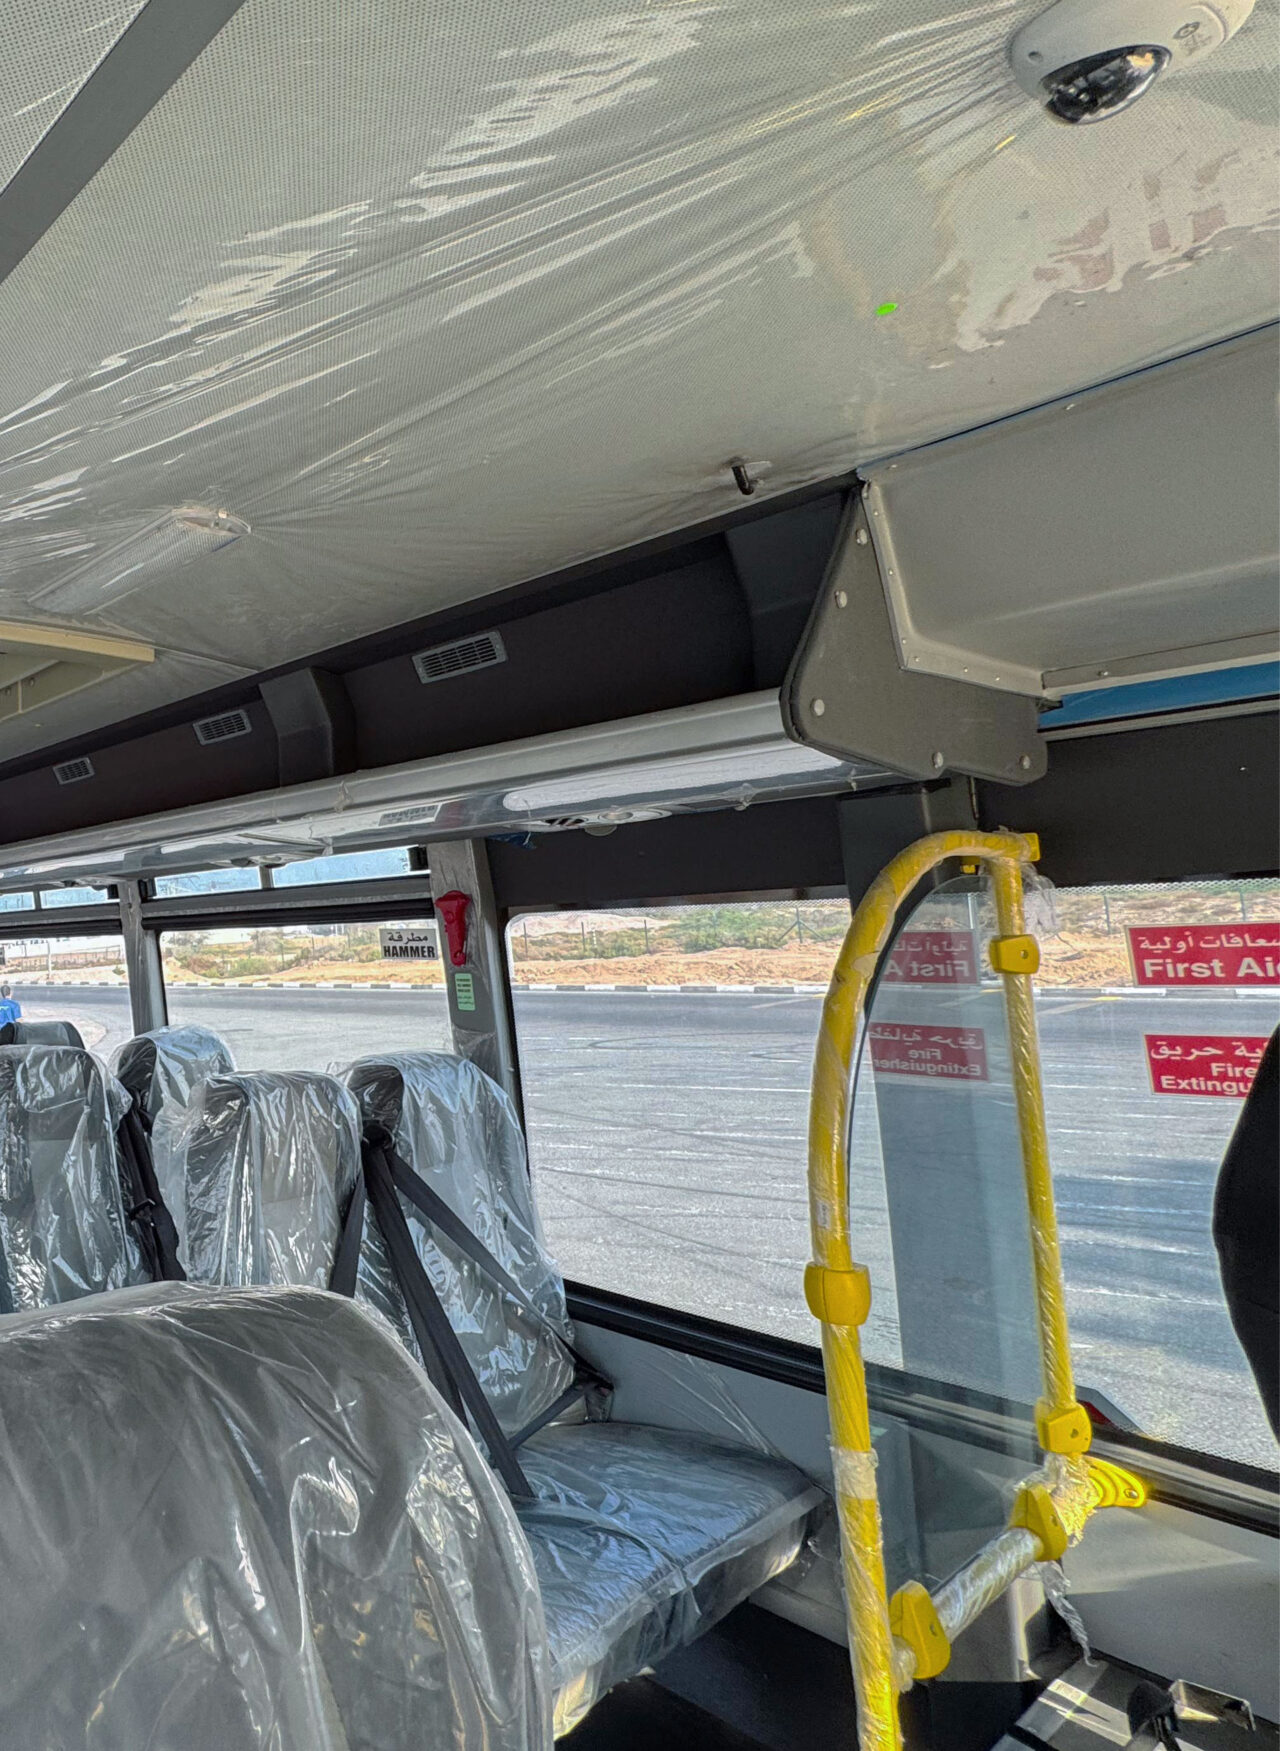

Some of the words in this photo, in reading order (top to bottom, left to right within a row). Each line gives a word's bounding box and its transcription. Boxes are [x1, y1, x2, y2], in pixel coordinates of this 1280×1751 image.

[387, 931, 429, 945] مطرقة
[1137, 931, 1195, 954] أولية
[1199, 932, 1280, 949] عافات
[383, 945, 435, 959] HAMMER
[1143, 958, 1226, 979] First
[1150, 1041, 1224, 1061] حريق
[1210, 1062, 1258, 1077] Fire
[1160, 1075, 1253, 1096] Extingu
